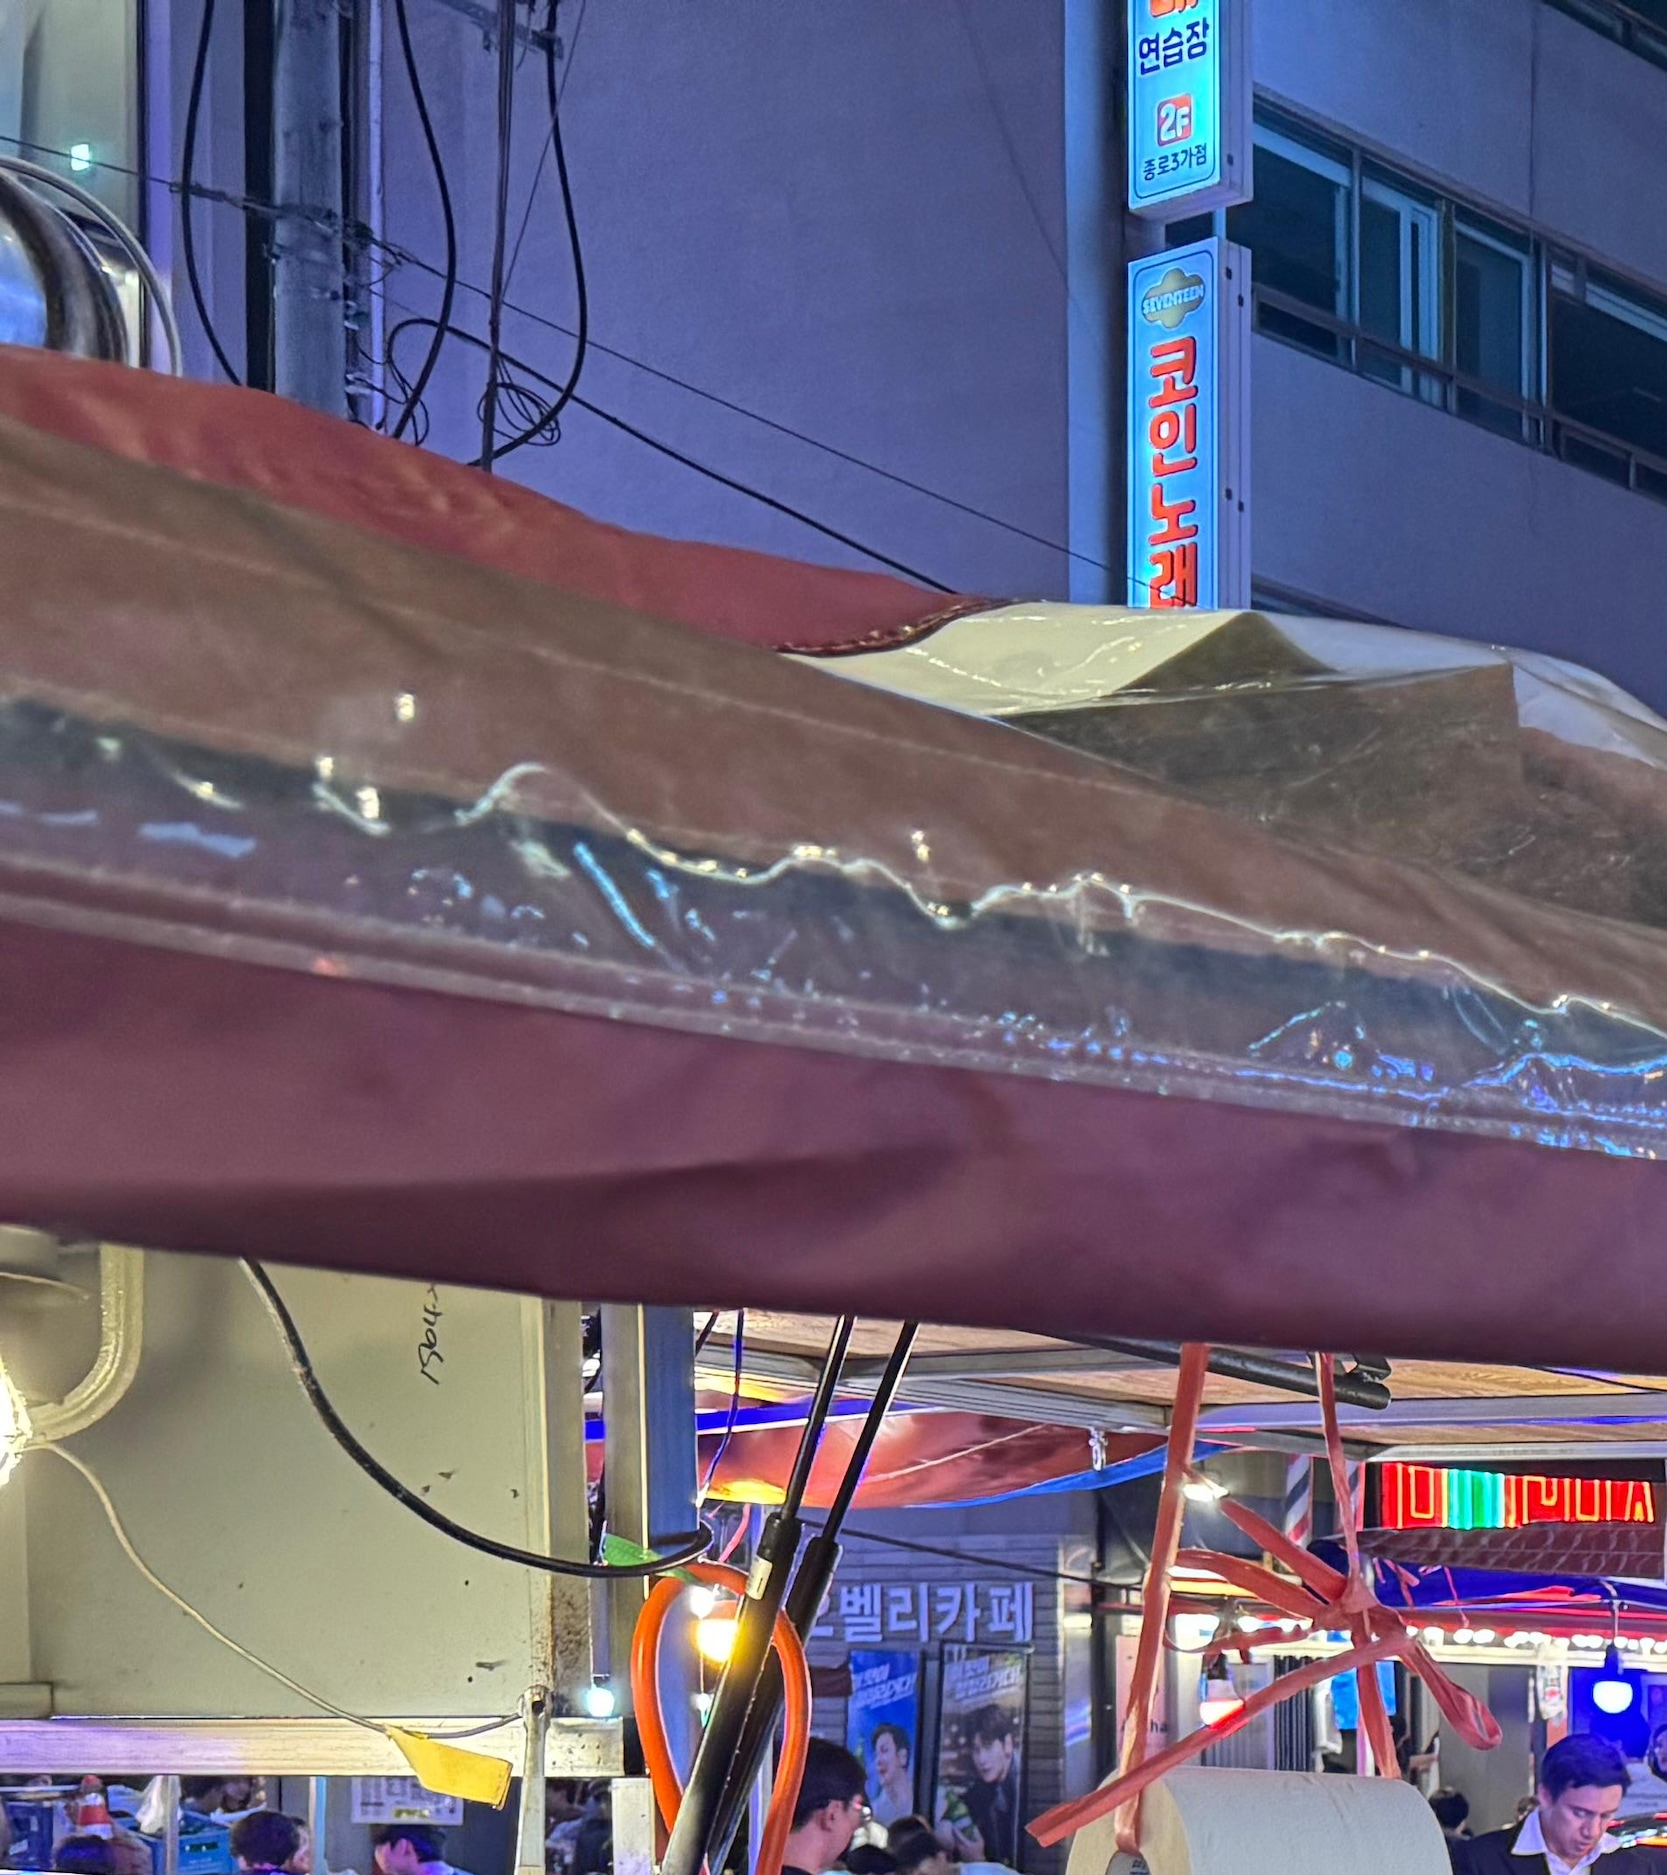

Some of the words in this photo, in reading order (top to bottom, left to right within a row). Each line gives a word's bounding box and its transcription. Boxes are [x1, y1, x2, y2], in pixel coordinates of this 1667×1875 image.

[1139, 17, 1209, 75] 연습장
[1160, 103, 1190, 141] 2F
[1143, 144, 1208, 182] 종로3가점
[1142, 284, 1205, 316] SEVENTEEN
